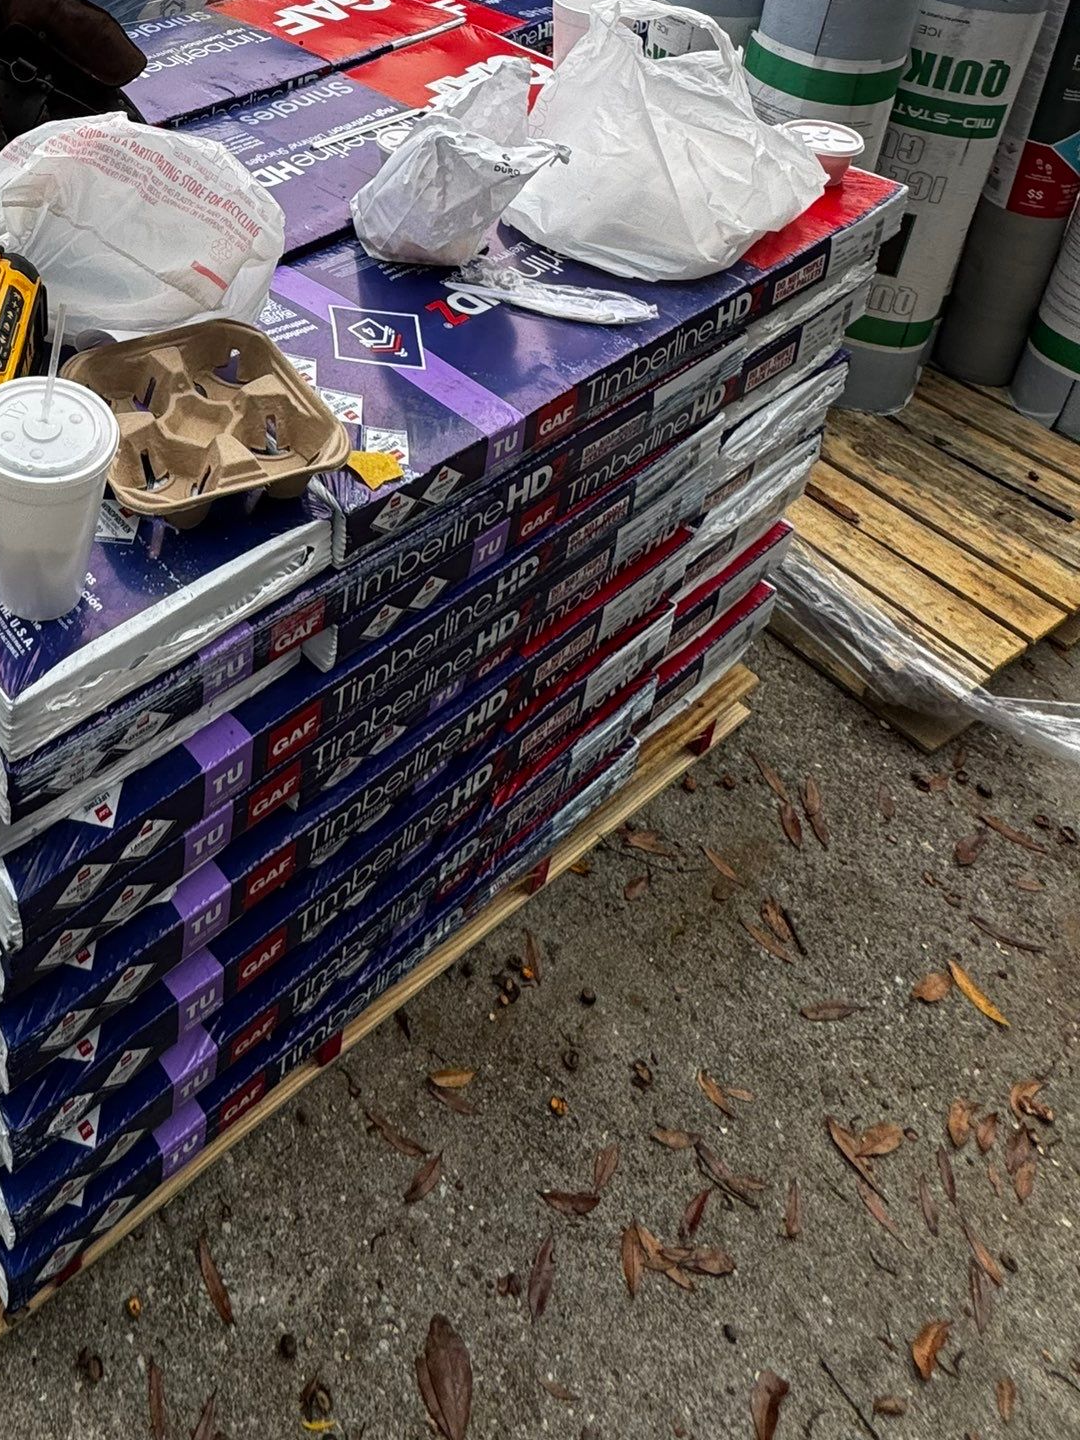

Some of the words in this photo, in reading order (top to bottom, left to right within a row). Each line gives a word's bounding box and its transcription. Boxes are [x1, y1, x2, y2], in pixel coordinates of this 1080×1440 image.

[128, 11, 213, 40] Shingle
[902, 47, 1011, 98] QUIK
[238, 80, 355, 126] Shingles
[894, 102, 996, 130] MID-STAT
[128, 141, 183, 183] PARTICIPATING
[178, 174, 208, 199] STORE
[202, 190, 224, 208] FOR
[220, 199, 263, 239] RECYCLING
[586, 319, 714, 408] Timberline
[539, 405, 574, 436] GAF
[494, 431, 519, 459] TU
[567, 413, 692, 506] Timberline
[520, 505, 555, 537] GAF
[335, 500, 504, 614] Timberline
[477, 536, 502, 562] TU
[9, 618, 35, 652] U.S.A.
[274, 613, 320, 653] GAF
[332, 593, 493, 714] Timberline
[312, 647, 473, 772] Timberline
[272, 715, 319, 758] GAF
[212, 760, 245, 795] TU
[252, 776, 298, 817] GAF
[307, 728, 462, 851] Timberline
[192, 822, 225, 856] TU
[249, 856, 293, 896] GAF
[298, 802, 450, 931] Timberline
[190, 902, 223, 936] TU
[241, 938, 284, 979] GAF
[185, 987, 217, 1021] TU
[233, 1016, 276, 1056] GAF
[180, 1066, 209, 1098] TU
[222, 1083, 264, 1124] GAF
[168, 1134, 200, 1166] TU
